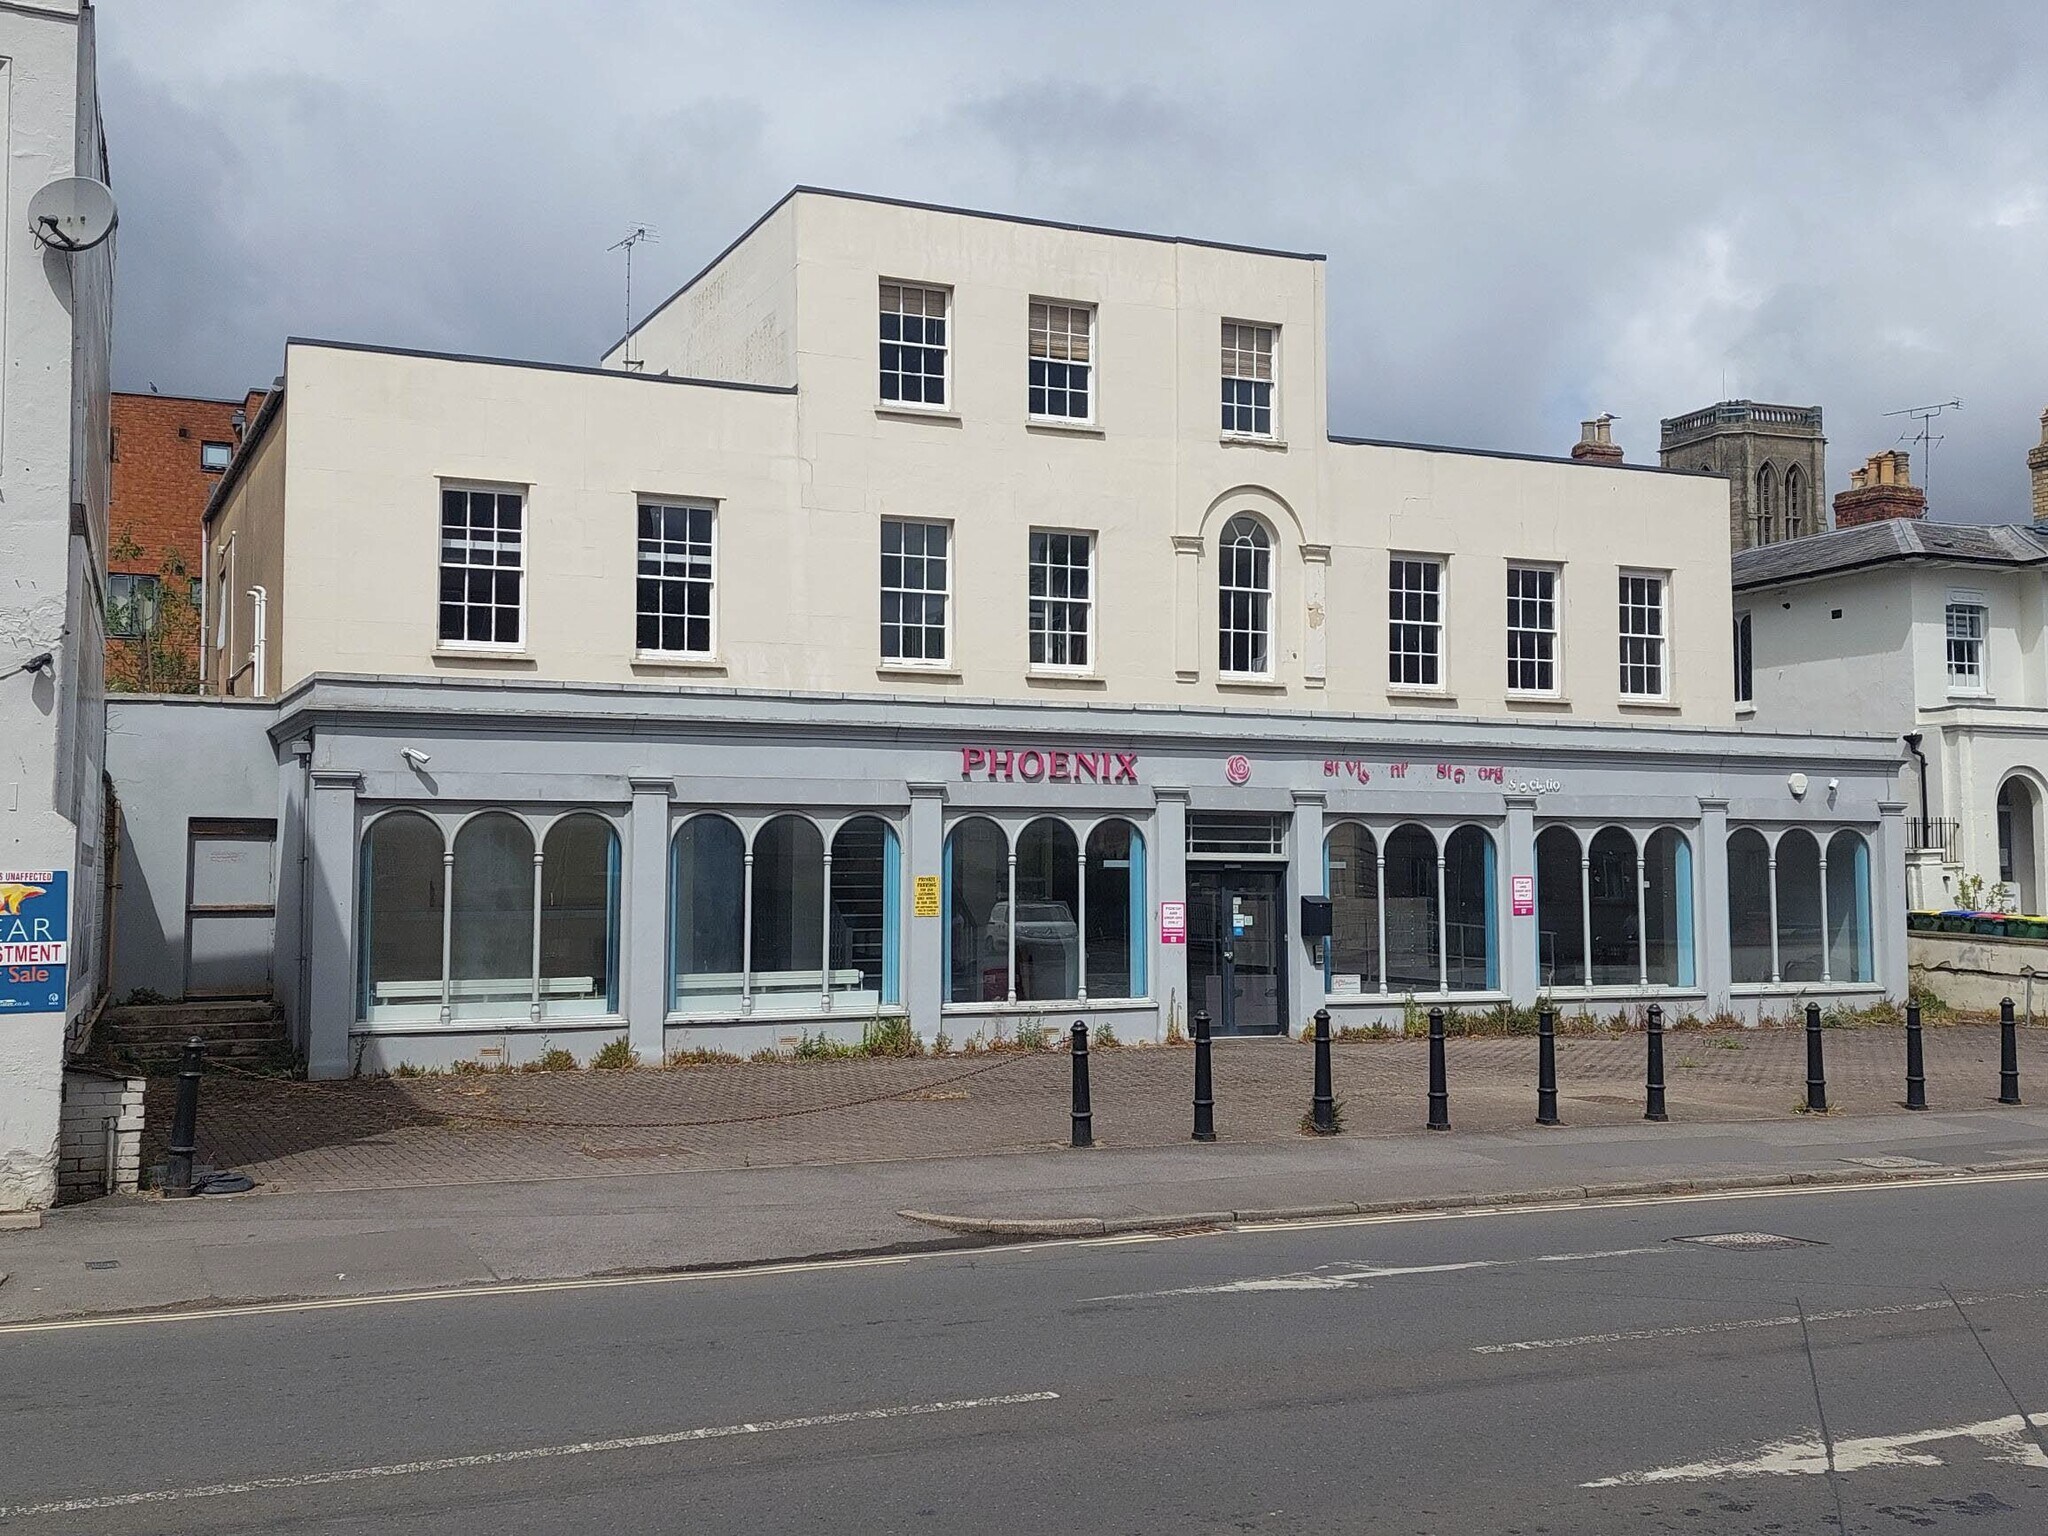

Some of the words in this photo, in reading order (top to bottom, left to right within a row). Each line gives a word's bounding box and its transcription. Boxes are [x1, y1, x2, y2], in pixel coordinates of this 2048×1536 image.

[962, 747, 1138, 779] PHOENIX
[6, 872, 52, 881] UNAFFECTED
[0, 918, 53, 942] AR
[8, 966, 49, 983] Sale
